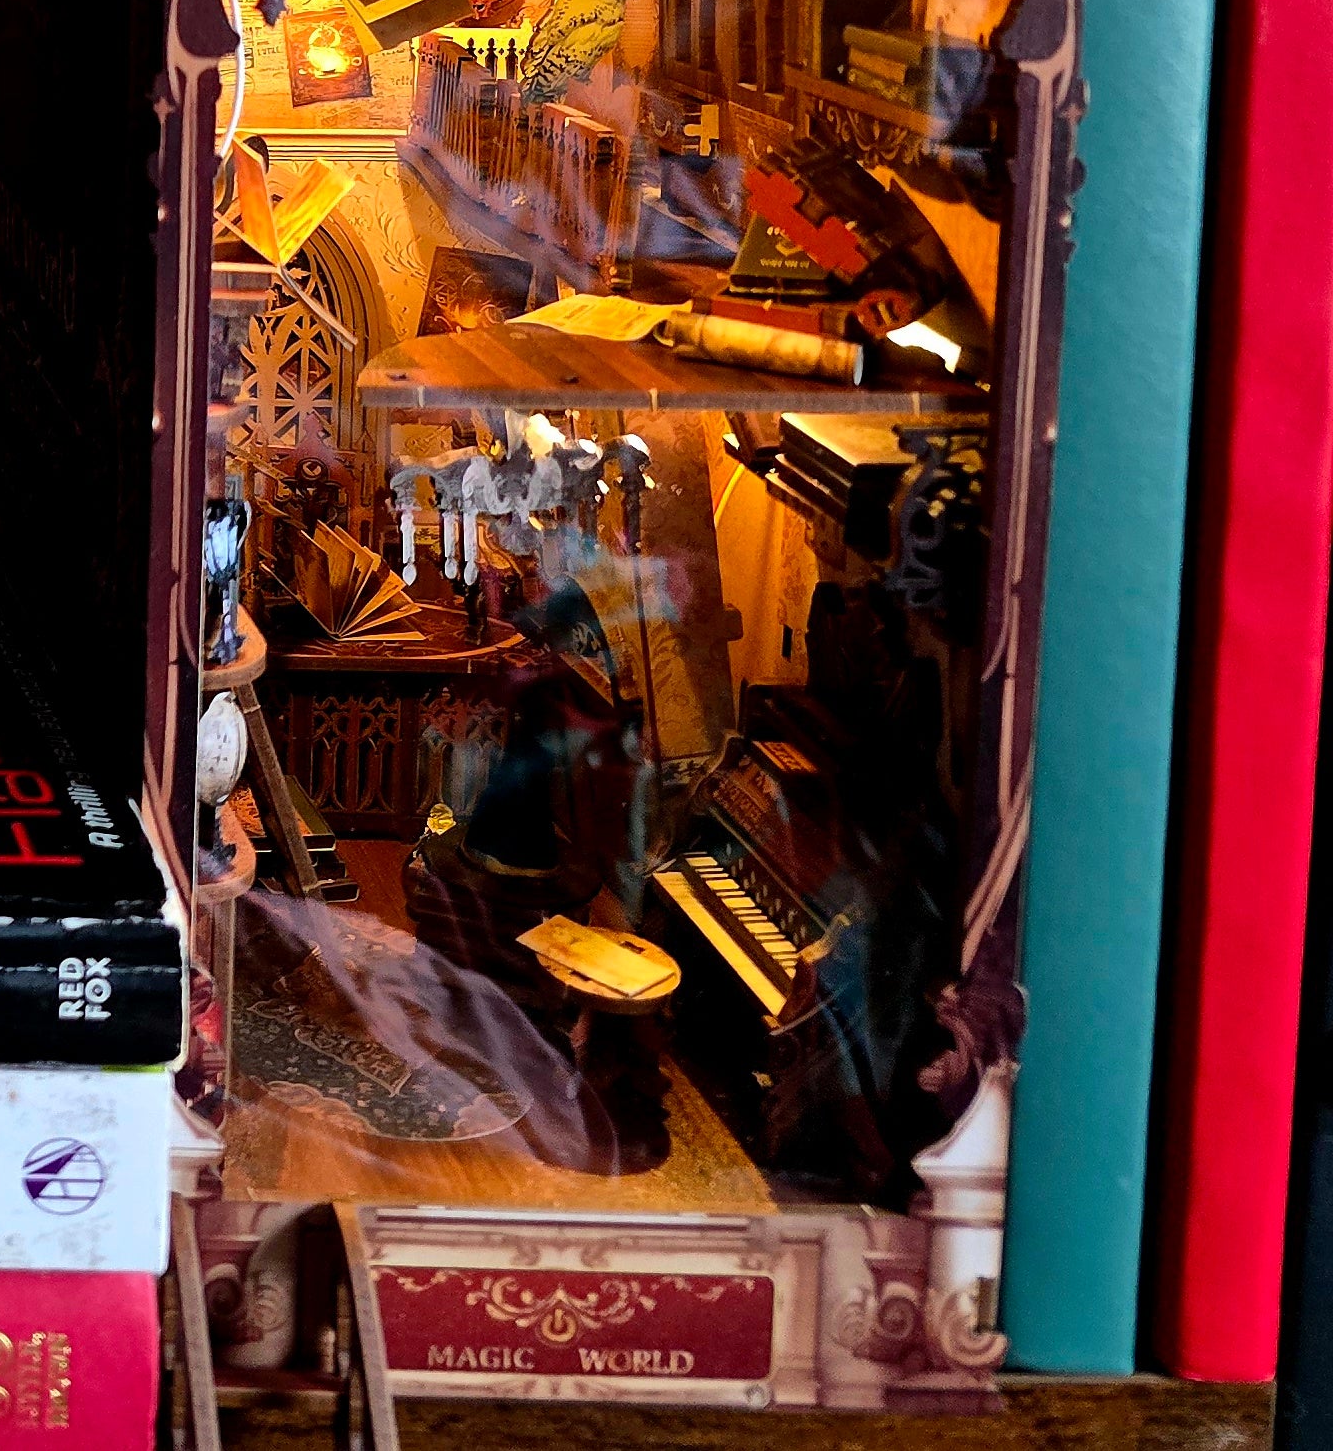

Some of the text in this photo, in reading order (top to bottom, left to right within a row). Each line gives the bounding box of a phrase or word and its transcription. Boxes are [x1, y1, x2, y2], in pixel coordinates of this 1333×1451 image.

[59, 957, 85, 1020] RED
[85, 957, 112, 1020] FOX
[427, 1345, 695, 1375] MAGIC WORLD
